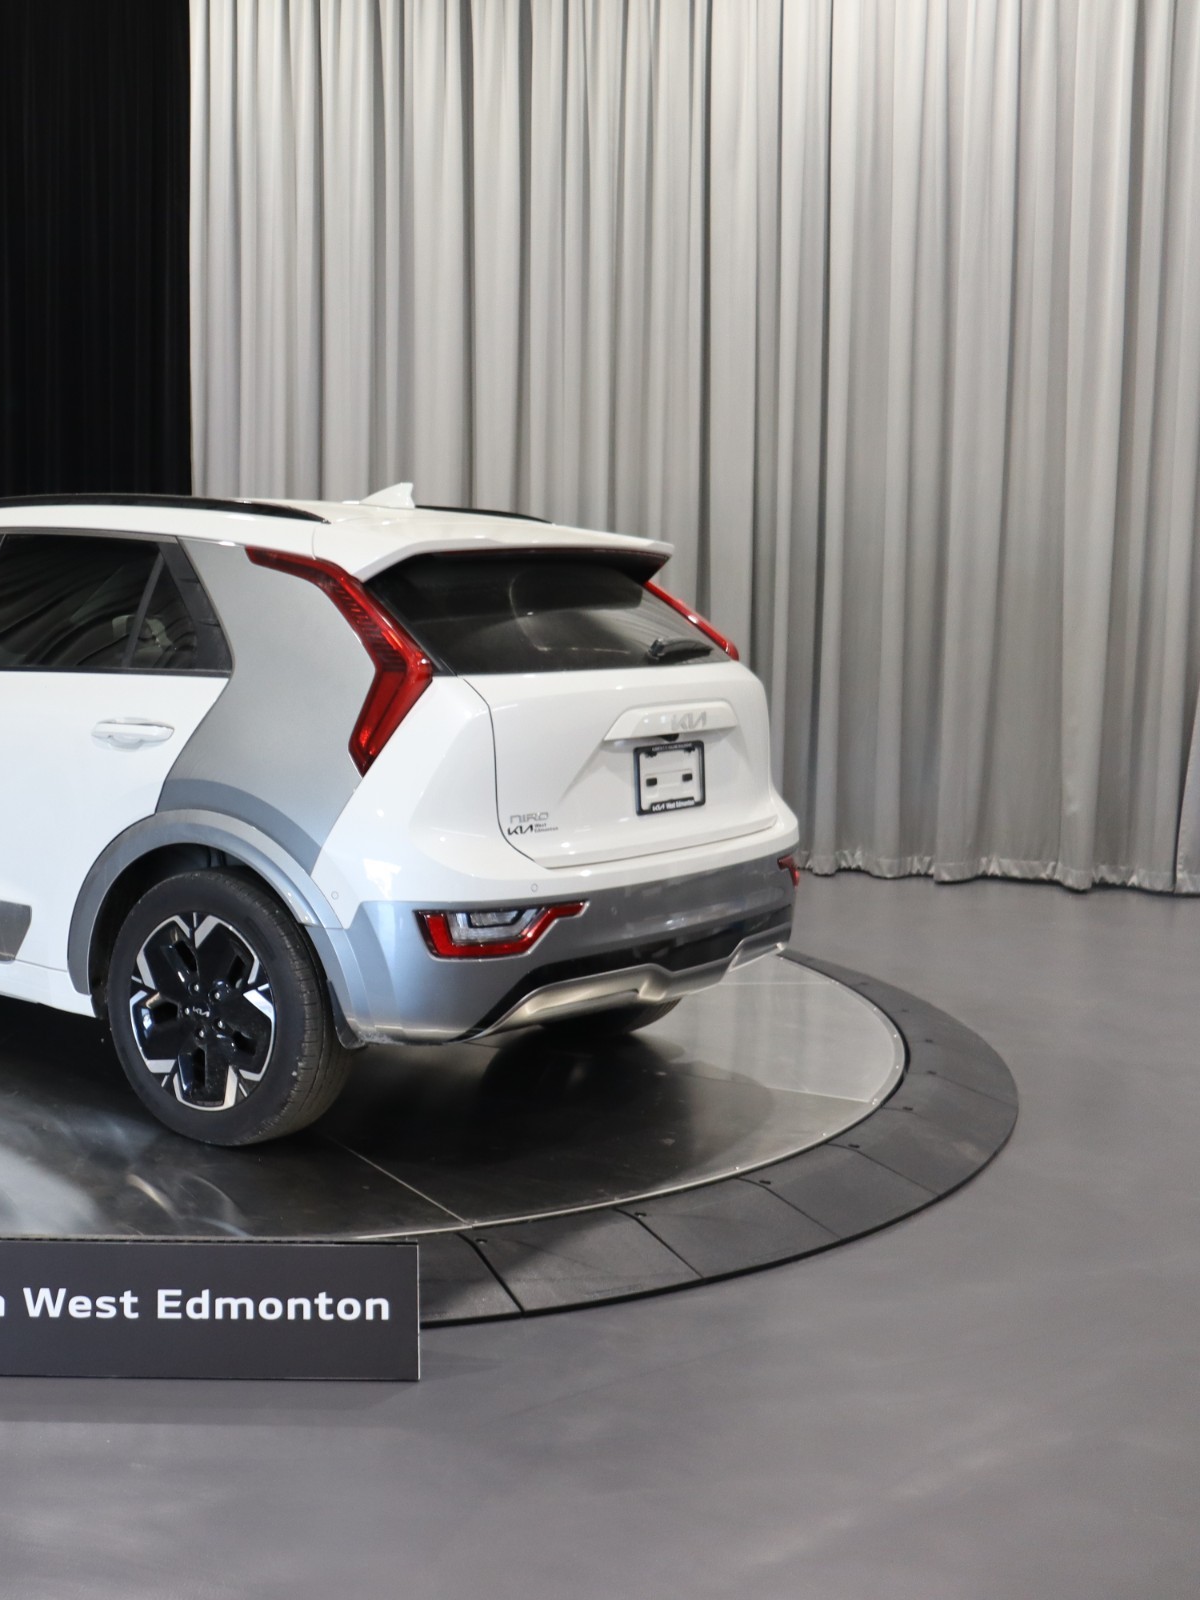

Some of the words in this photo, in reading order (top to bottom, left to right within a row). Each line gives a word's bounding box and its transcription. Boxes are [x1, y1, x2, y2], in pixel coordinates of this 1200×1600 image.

[670, 711, 707, 731] KIA
[507, 824, 533, 836] KIA
[22, 1287, 139, 1320] West
[157, 1288, 390, 1321] Edmonton
